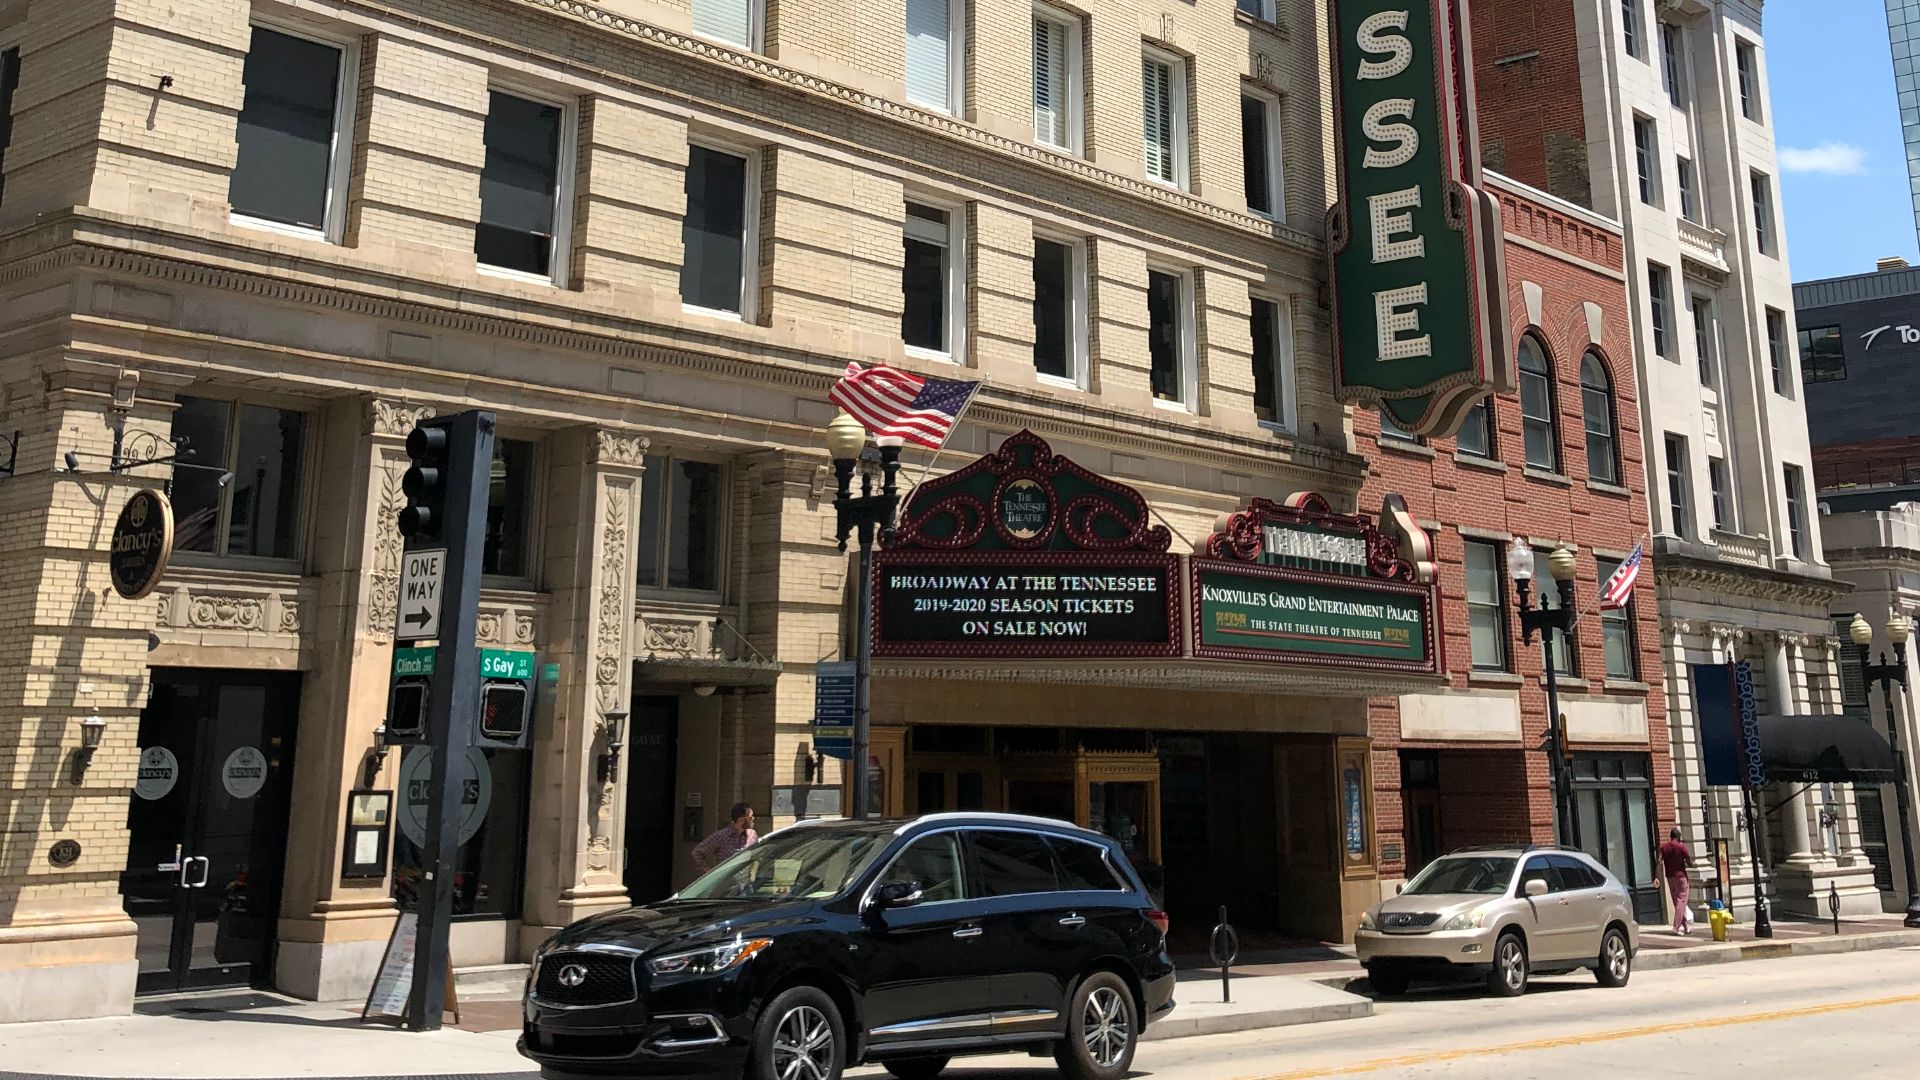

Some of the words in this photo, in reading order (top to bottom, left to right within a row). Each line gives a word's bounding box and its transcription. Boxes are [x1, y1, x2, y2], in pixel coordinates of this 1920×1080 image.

[1016, 493, 1033, 502] THE
[1003, 501, 1047, 512] TENNESSEE
[1006, 511, 1043, 522] THEATRE
[1262, 525, 1367, 567] TENNESSEE
[410, 557, 438, 577] ONE
[407, 581, 436, 600] WAY
[890, 576, 991, 590] BROADWAY
[995, 576, 1019, 590] AT
[1022, 576, 1056, 590] THE
[1059, 577, 1157, 591] TENNESSEE
[914, 599, 986, 612] 2019-2020
[990, 599, 1059, 613] SEASON
[1063, 599, 1134, 613] TICKETS
[1202, 584, 1267, 607] KNOXVILLE'S
[1269, 592, 1306, 610] GRAND
[1308, 596, 1384, 619] ENTERTAINMENT
[1386, 604, 1419, 622] PALACE
[962, 621, 989, 635] ON
[993, 621, 1037, 635] SALE
[1040, 622, 1087, 636] NOW!
[1250, 619, 1266, 630] THE
[1269, 621, 1293, 632] STATE
[1295, 623, 1328, 635] THEATRE
[1330, 626, 1340, 636] OF
[1342, 628, 1382, 640] TENNESSEE
[397, 657, 421, 673] Clinch
[483, 658, 491, 672] S
[493, 657, 514, 677] Gay
[520, 659, 527, 667] ST
[1802, 771, 1819, 780] 612
